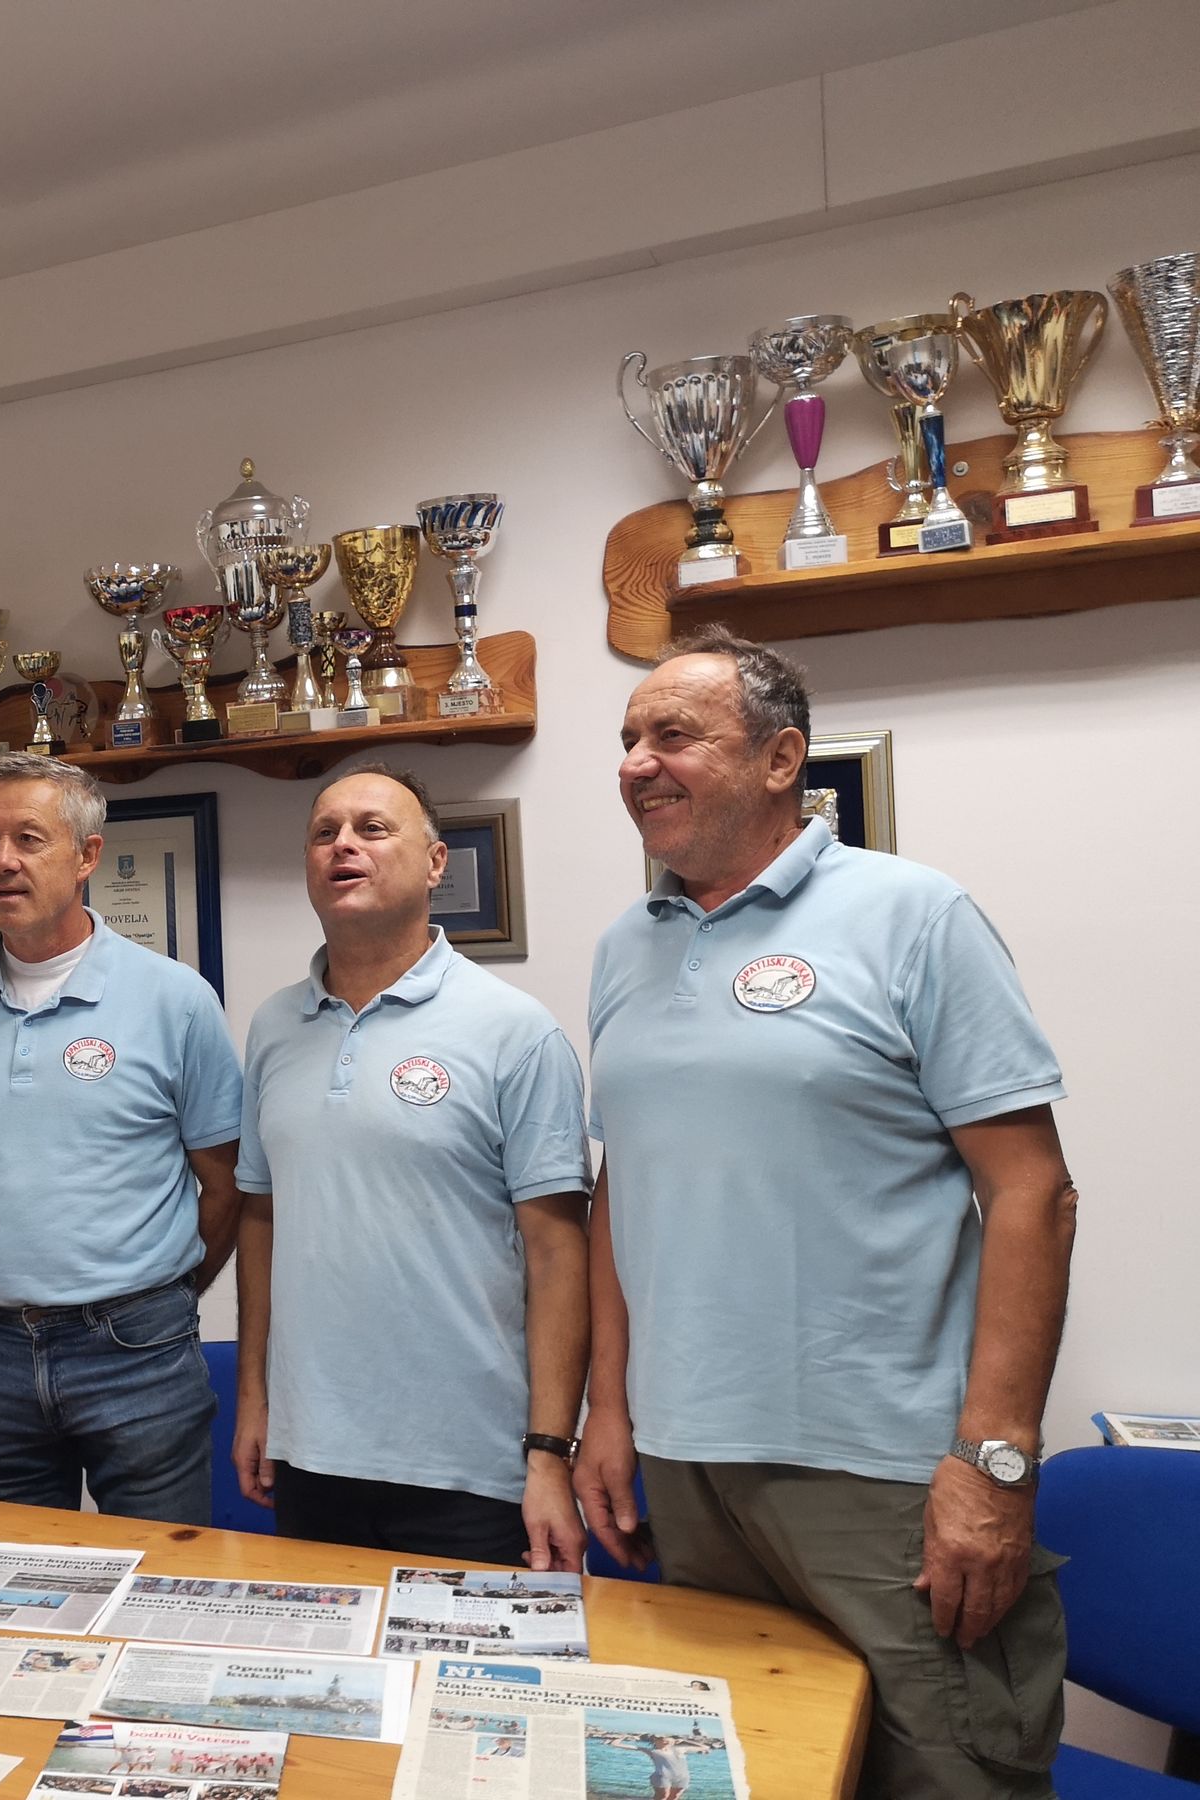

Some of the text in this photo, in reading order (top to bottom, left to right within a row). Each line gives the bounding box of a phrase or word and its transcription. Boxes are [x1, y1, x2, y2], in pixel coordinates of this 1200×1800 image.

[104, 914, 149, 924] POVELJA
[738, 957, 813, 988] OPATIJSKI KUKALI
[66, 1040, 97, 1057] OPATIJSKI
[393, 1059, 430, 1077] OPATIJSKI
[48, 1558, 102, 1567] kupanje
[125, 1596, 181, 1605] Hladni
[187, 1600, 231, 1608] Bajer
[204, 1608, 284, 1616] opatijske
[226, 1671, 286, 1681] kukali
[227, 1664, 313, 1676] Opatijski
[444, 1665, 493, 1679] NL
[436, 1681, 496, 1692] Nakon
[435, 1689, 485, 1698] svijet
[543, 1698, 610, 1708] odmah
[657, 1707, 719, 1718] boljim
[129, 1730, 182, 1739] bodrili
[186, 1734, 250, 1745] Vatrene
